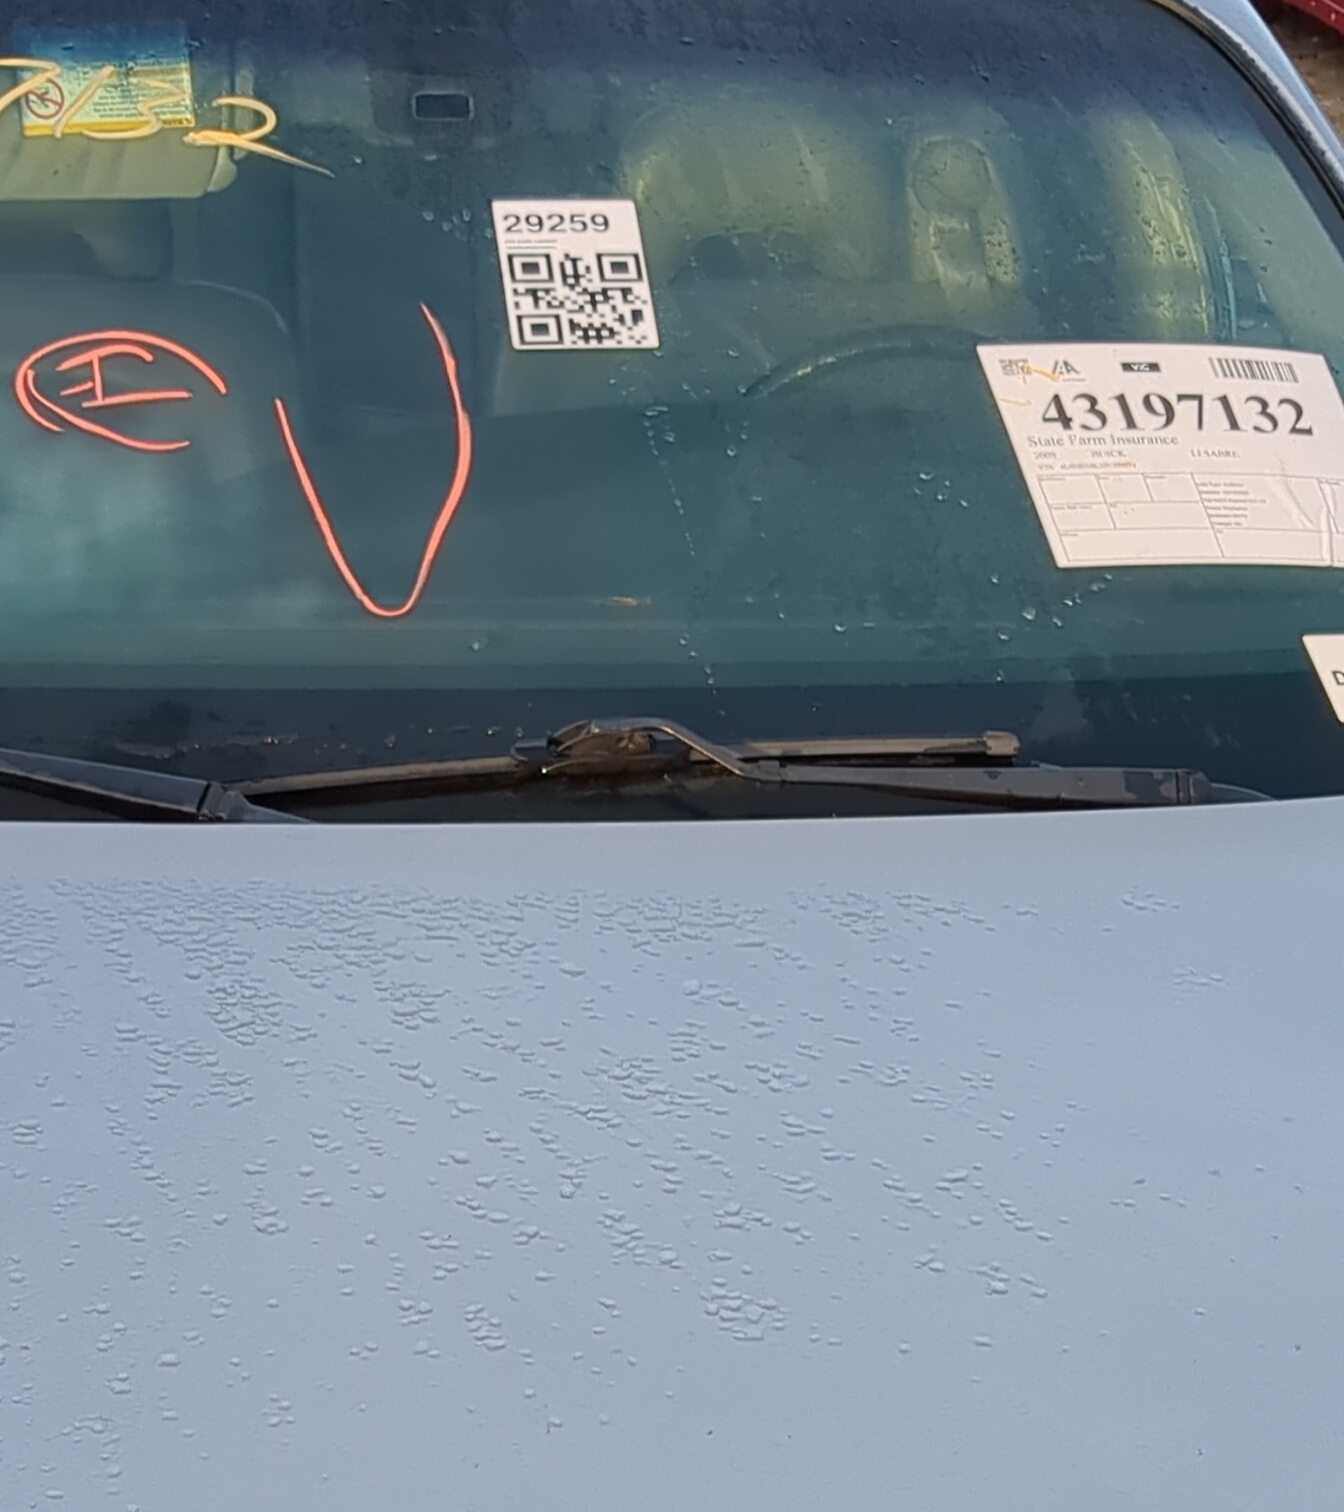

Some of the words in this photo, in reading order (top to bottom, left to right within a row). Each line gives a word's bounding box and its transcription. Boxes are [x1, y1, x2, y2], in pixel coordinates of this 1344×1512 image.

[502, 213, 610, 233] 29259
[1041, 392, 1314, 436] 43197132
[1027, 435, 1065, 447] State
[1067, 434, 1106, 446] Farm
[1109, 433, 1179, 446] Insurance
